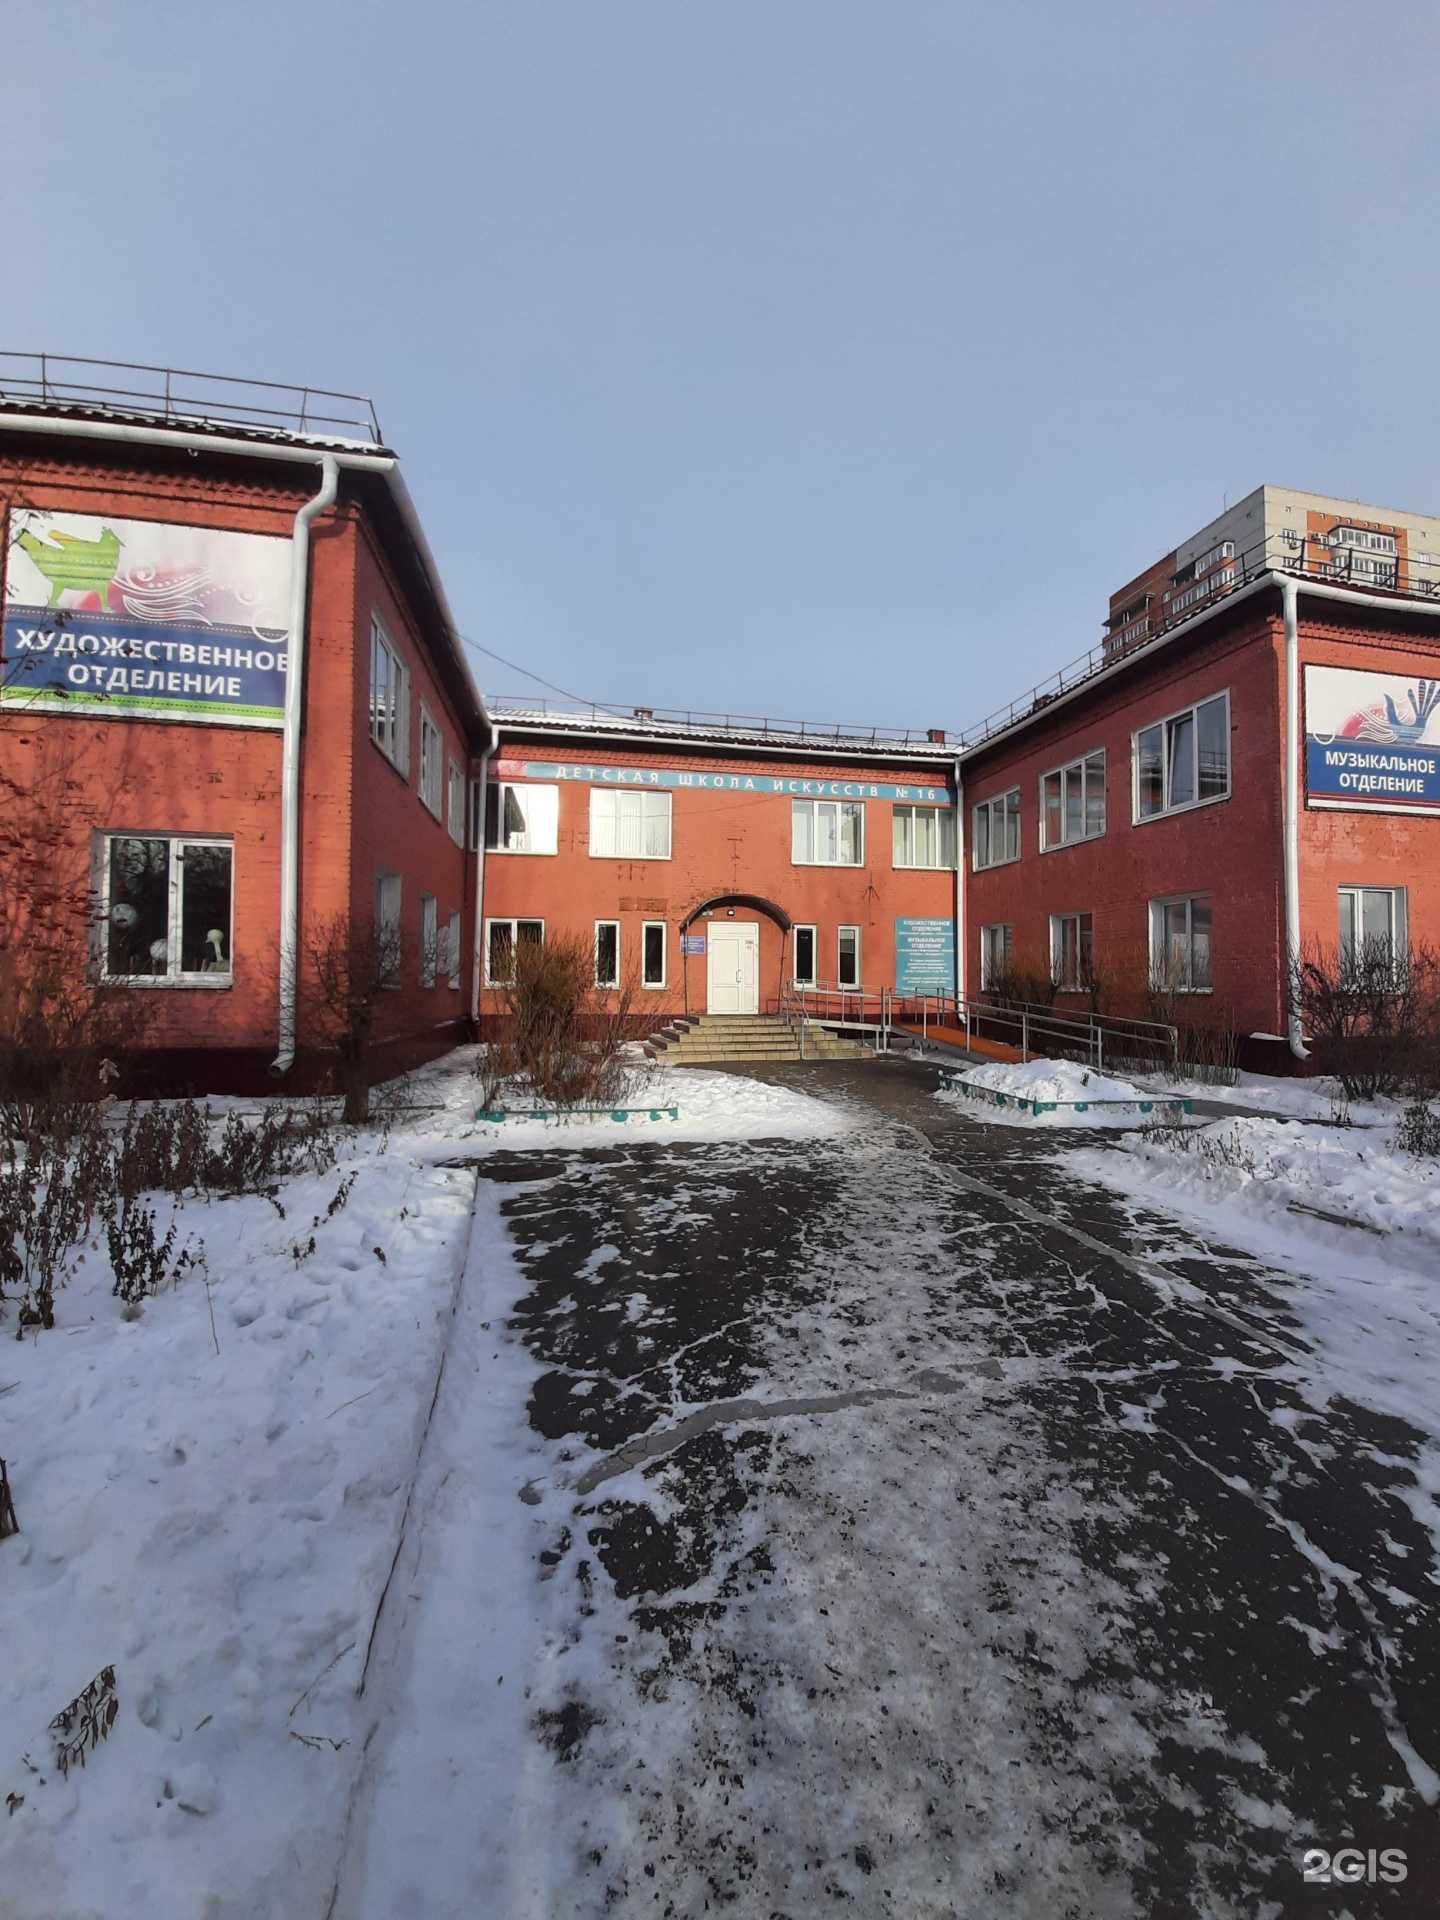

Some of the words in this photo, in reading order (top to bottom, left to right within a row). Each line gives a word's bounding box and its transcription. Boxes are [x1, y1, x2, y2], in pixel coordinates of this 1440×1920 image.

[16, 629, 288, 672] ХУДОЖЕСТВЕННОЕ
[68, 664, 241, 697] ОТДЕЛЕНИЕ
[1325, 751, 1436, 774] МУЗЫКАЛЬНОЕ
[556, 766, 659, 785] ДЕТСКАЯ
[679, 774, 754, 791] ШКОЛА
[773, 780, 878, 797] ИСКУССТВ
[895, 787, 908, 799] №
[917, 789, 935, 800] 16
[1339, 773, 1424, 793] ОТДЕЛЕНИЕ
